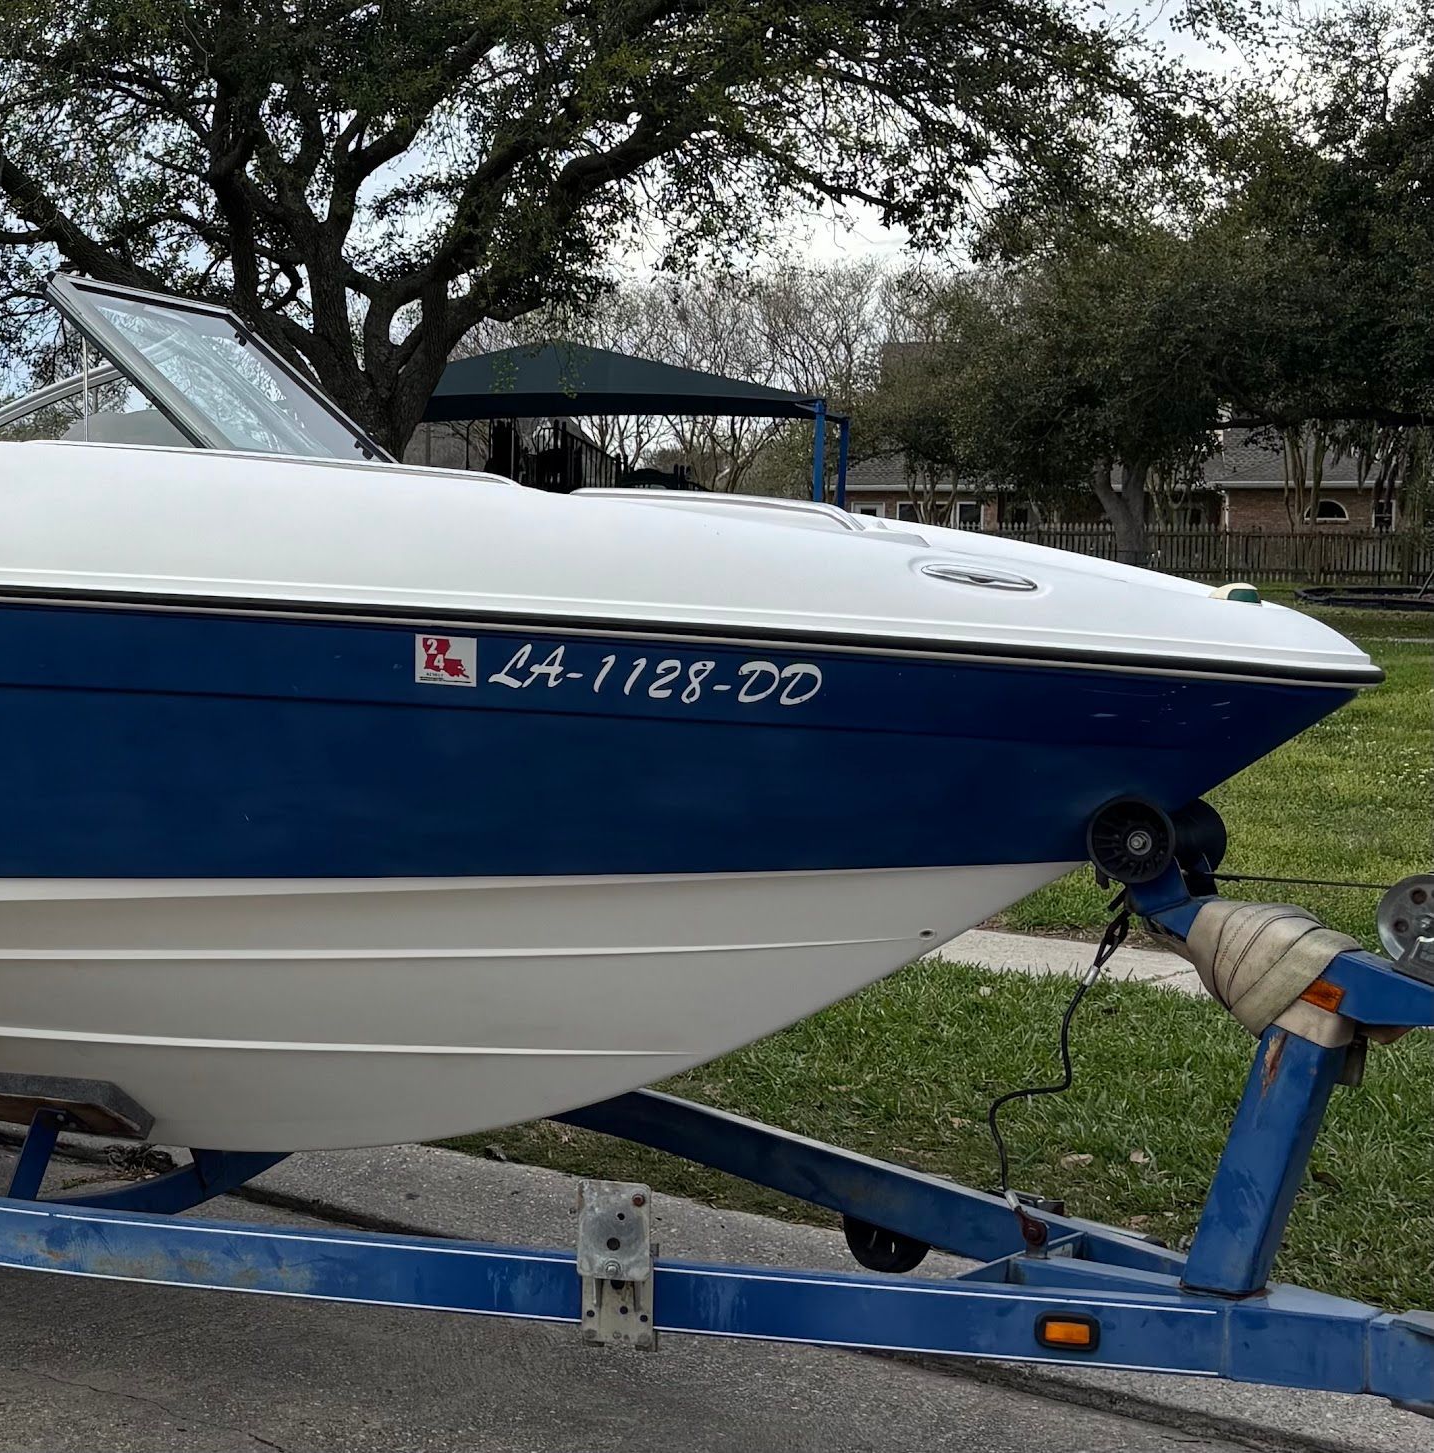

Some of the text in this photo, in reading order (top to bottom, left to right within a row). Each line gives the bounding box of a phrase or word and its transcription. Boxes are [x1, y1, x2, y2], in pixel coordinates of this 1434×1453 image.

[426, 639, 438, 655] 2
[433, 654, 445, 670] 4
[488, 643, 823, 705] LA-1128-DD
